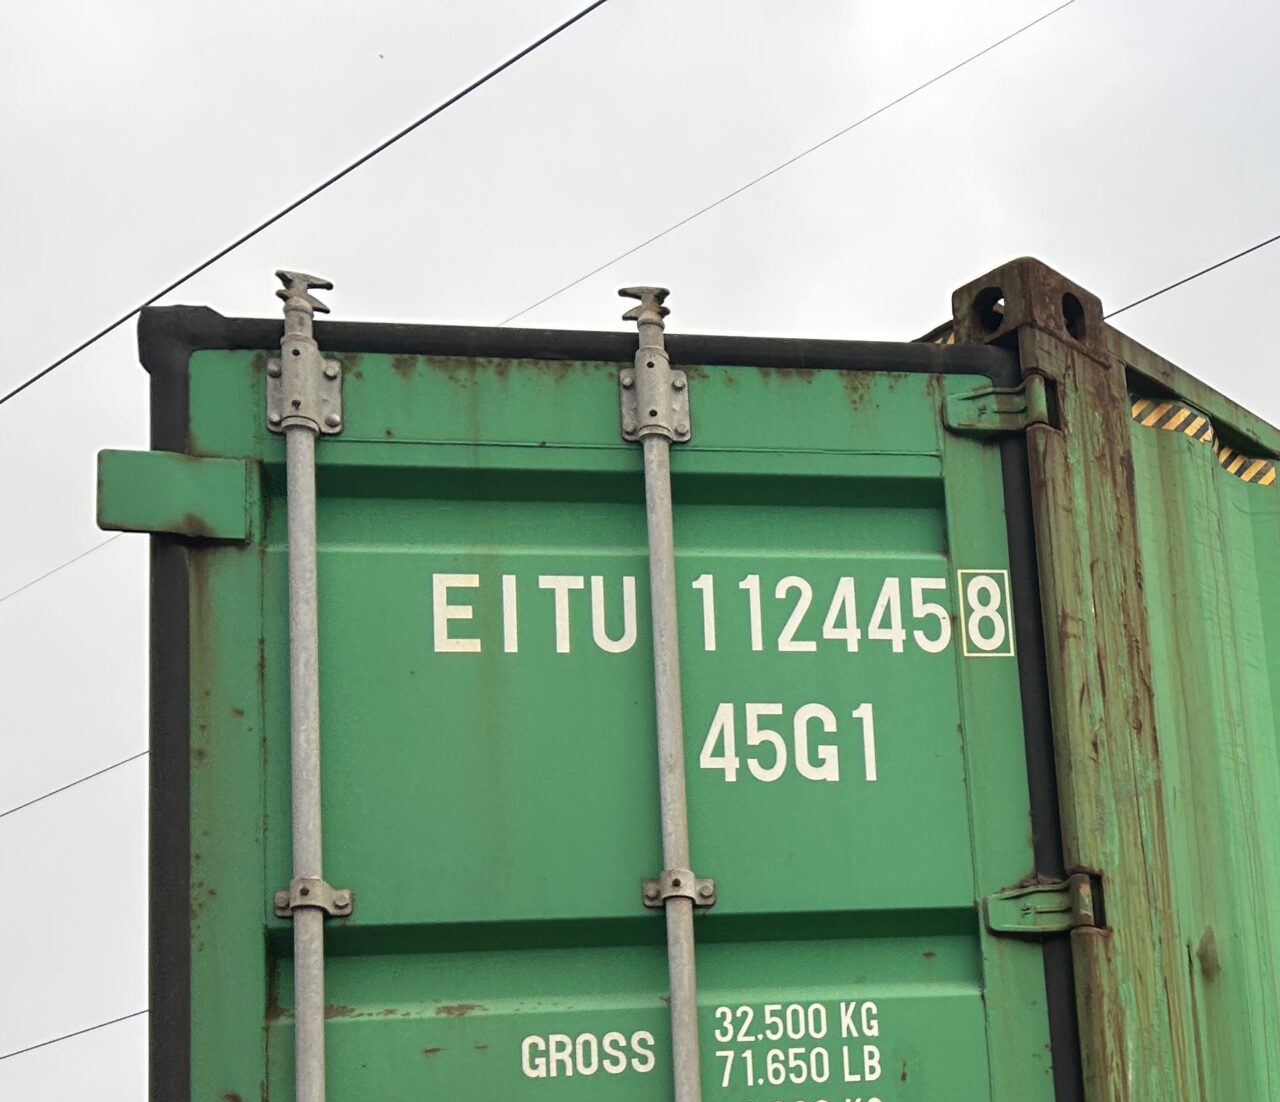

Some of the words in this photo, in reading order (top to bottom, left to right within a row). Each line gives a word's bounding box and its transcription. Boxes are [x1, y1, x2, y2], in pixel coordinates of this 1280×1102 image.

[432, 573, 638, 654] EITU
[699, 702, 877, 782] 45G1
[840, 1001, 879, 1038] KG
[521, 1030, 655, 1078] GROSS
[842, 1044, 882, 1082] LB
